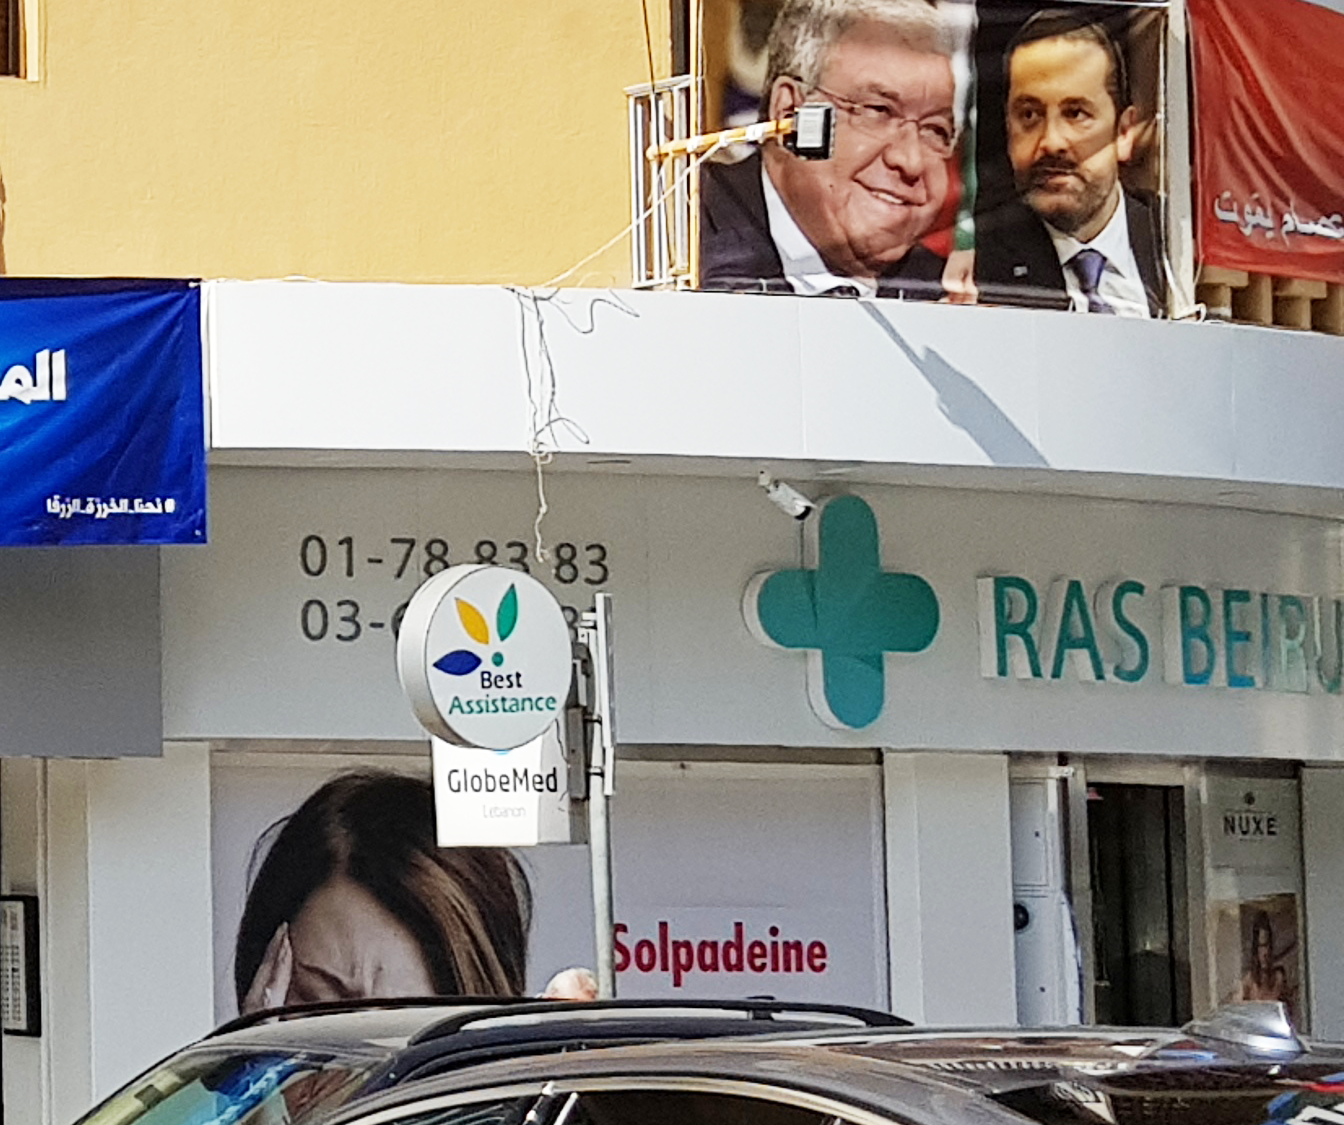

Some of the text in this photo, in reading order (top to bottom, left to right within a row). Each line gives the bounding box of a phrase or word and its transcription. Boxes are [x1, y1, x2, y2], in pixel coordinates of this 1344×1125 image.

[553, 541, 610, 585] 83
[992, 575, 1151, 683] RAS
[480, 671, 523, 689] Best
[448, 694, 557, 715] Assistance
[447, 767, 558, 793] GlobeMed
[1223, 815, 1278, 836] NUXE
[614, 921, 828, 988] Solpadeine
